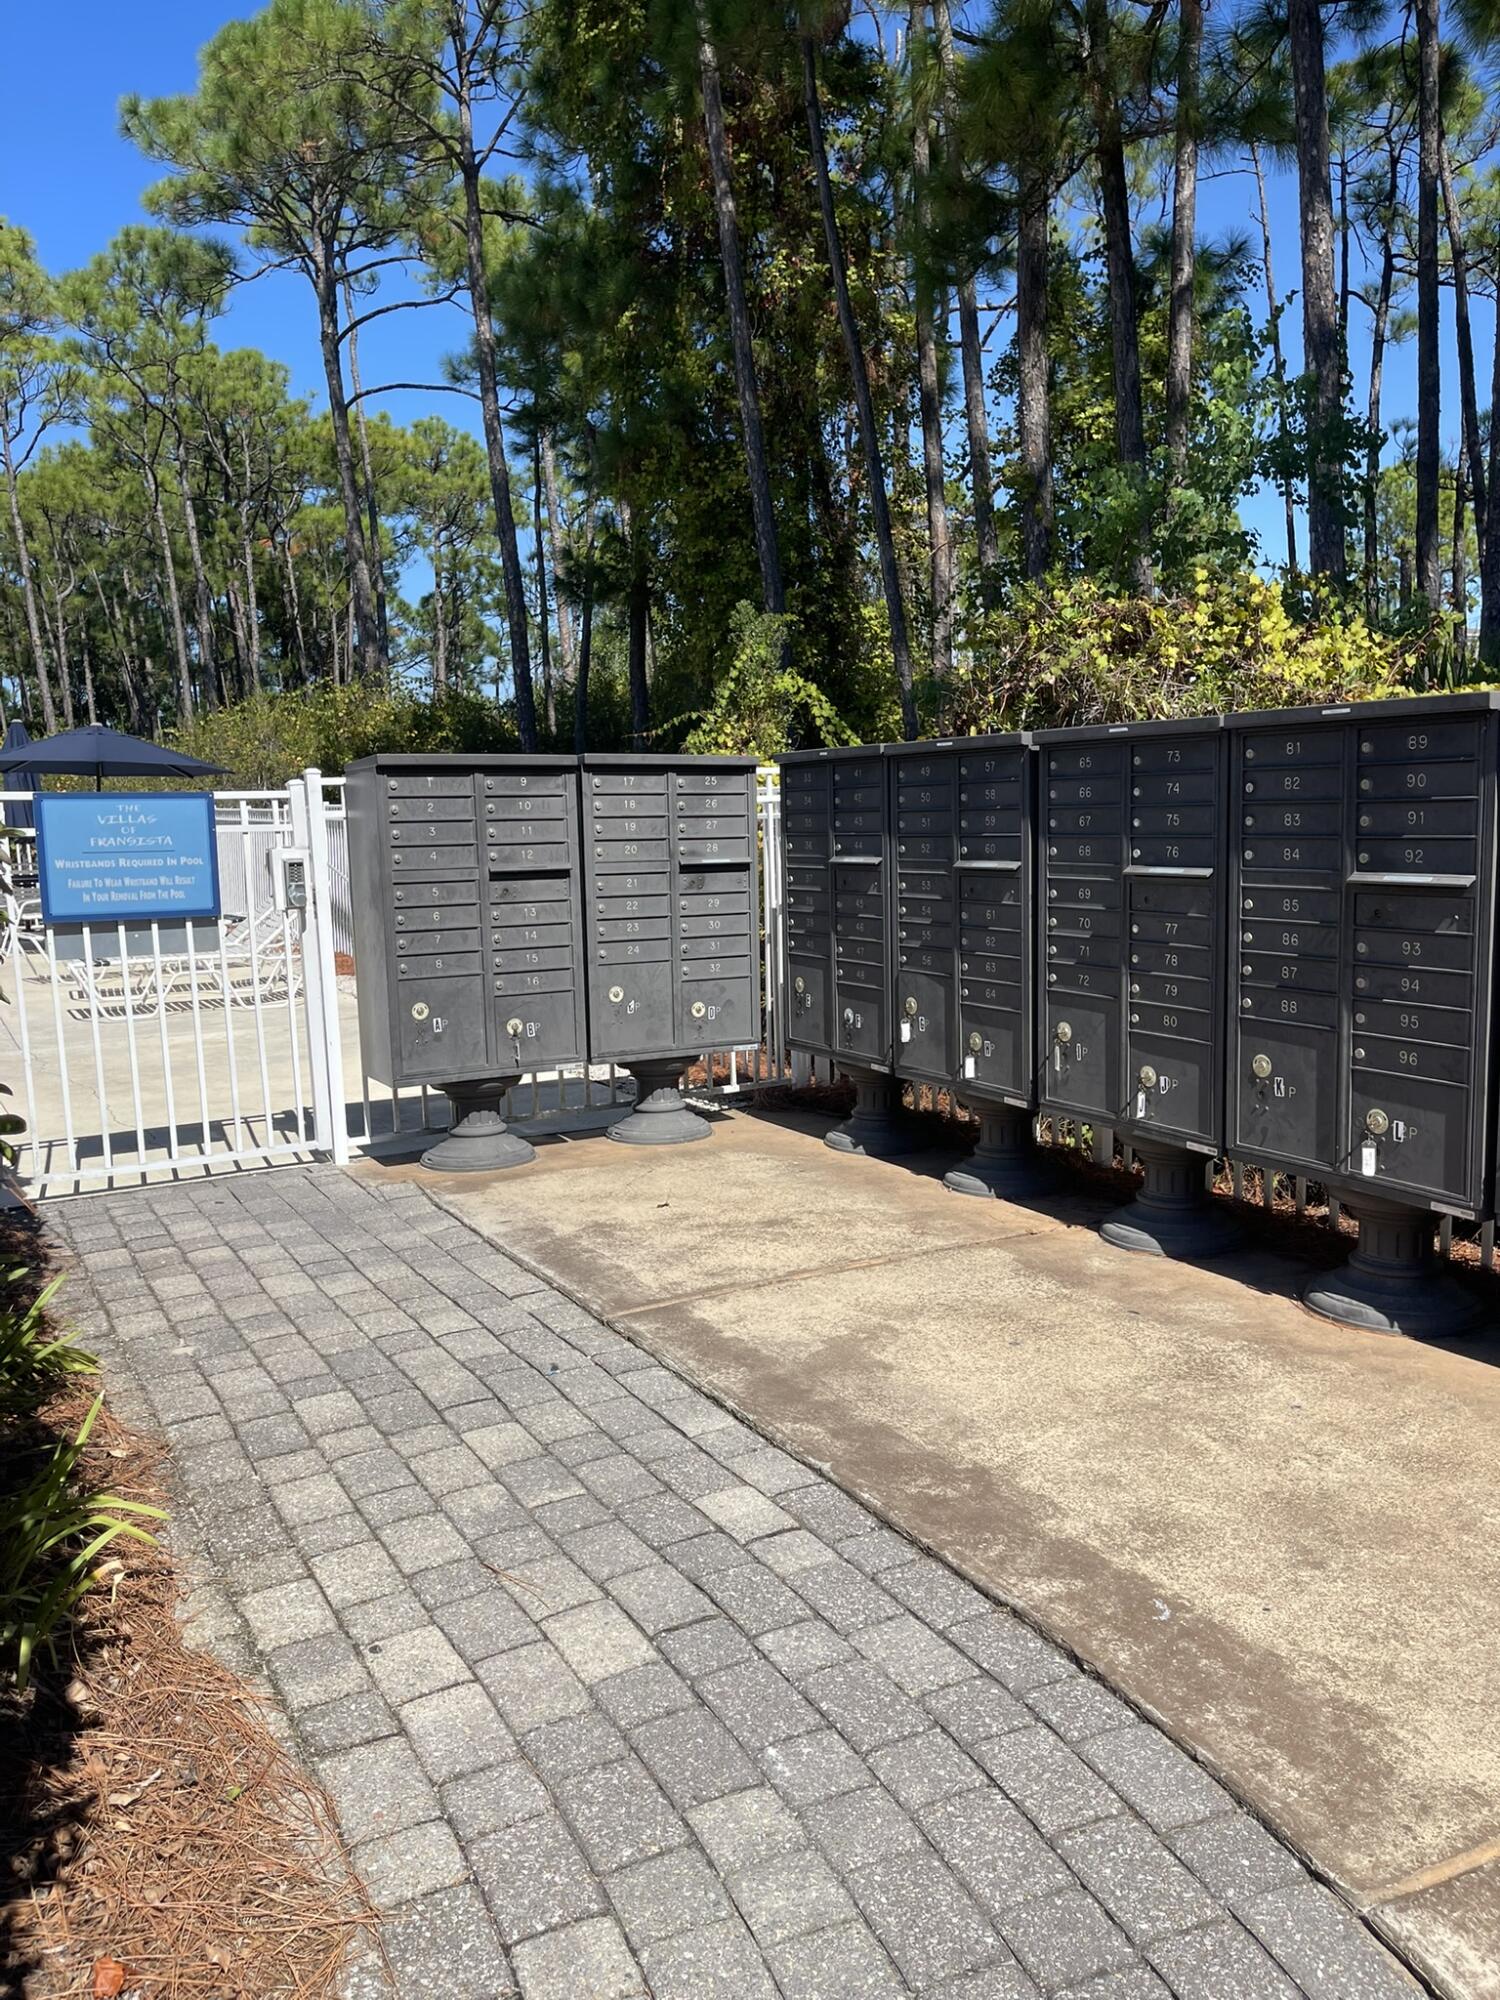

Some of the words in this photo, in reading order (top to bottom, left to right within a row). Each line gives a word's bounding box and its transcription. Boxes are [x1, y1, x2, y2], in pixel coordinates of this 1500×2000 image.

[1408, 735, 1427, 750] 89
[1286, 742, 1300, 755] 81
[1167, 750, 1181, 762] 73
[985, 761, 995, 772] 57
[1079, 757, 1092, 768] 65
[921, 766, 930, 776] 49
[427, 777, 434, 787] 1
[520, 777, 527, 786] 9
[624, 776, 634, 786] 17
[705, 776, 717, 785] 25
[1284, 776, 1300, 790] 82
[1407, 773, 1426, 788] 90
[1079, 787, 1092, 798] 66
[1167, 782, 1179, 794] 74
[921, 792, 930, 802] 50
[985, 789, 996, 800] 58
[117, 804, 141, 812] THE
[427, 802, 434, 812] 2
[519, 801, 531, 810] 10
[624, 800, 636, 809] 18
[705, 799, 717, 808] 26
[96, 814, 158, 824] VILLAS
[921, 817, 930, 827] 51
[985, 815, 996, 826] 59
[1079, 816, 1091, 827] 67
[1166, 814, 1180, 826] 75
[1284, 813, 1300, 826] 83
[1408, 811, 1424, 825] 91
[625, 822, 636, 831] 19
[706, 820, 718, 829] 27
[429, 827, 436, 836] 3
[521, 826, 532, 835] 11
[625, 845, 637, 854] 20
[706, 843, 718, 852] 28
[921, 843, 930, 853] 52
[985, 843, 996, 854] 60
[1079, 845, 1091, 856] 68
[1166, 846, 1179, 858] 76
[430, 851, 437, 860] 4
[521, 849, 533, 859] 12
[1283, 848, 1299, 861] 84
[1405, 849, 1423, 863] 92
[626, 878, 637, 888] 21
[922, 880, 931, 890] 53
[432, 887, 439, 897] 5
[1078, 888, 1091, 899] 69
[626, 901, 638, 910] 22
[708, 898, 720, 907] 29
[1283, 898, 1299, 912] 85
[524, 907, 536, 917] 13
[922, 906, 931, 915] 54
[986, 909, 995, 920] 61
[433, 911, 440, 921] 6
[627, 923, 639, 932] 23
[709, 920, 721, 929] 30
[1079, 917, 1091, 929] 70
[1165, 923, 1178, 934] 77
[434, 935, 441, 944] 7
[525, 930, 537, 940] 14
[922, 930, 931, 940] 55
[1282, 933, 1298, 946] 86
[710, 941, 720, 951] 31
[985, 936, 996, 947] 62
[627, 945, 639, 955] 24
[1079, 945, 1089, 956] 71
[1402, 941, 1421, 956] 93
[435, 959, 443, 968] 8
[526, 954, 538, 963] 15
[922, 955, 932, 965] 56
[1165, 954, 1178, 966] 78
[710, 963, 721, 972] 32
[985, 962, 996, 973] 63
[1281, 966, 1297, 979] 87
[527, 976, 539, 985] 16
[1078, 974, 1089, 986] 72
[1401, 978, 1419, 992] 94
[985, 988, 996, 999] 64
[1165, 984, 1177, 996] 79
[1281, 1000, 1297, 1013] 88
[1163, 1015, 1177, 1027] 80
[1400, 1014, 1419, 1029] 95
[1399, 1050, 1417, 1066] 96
